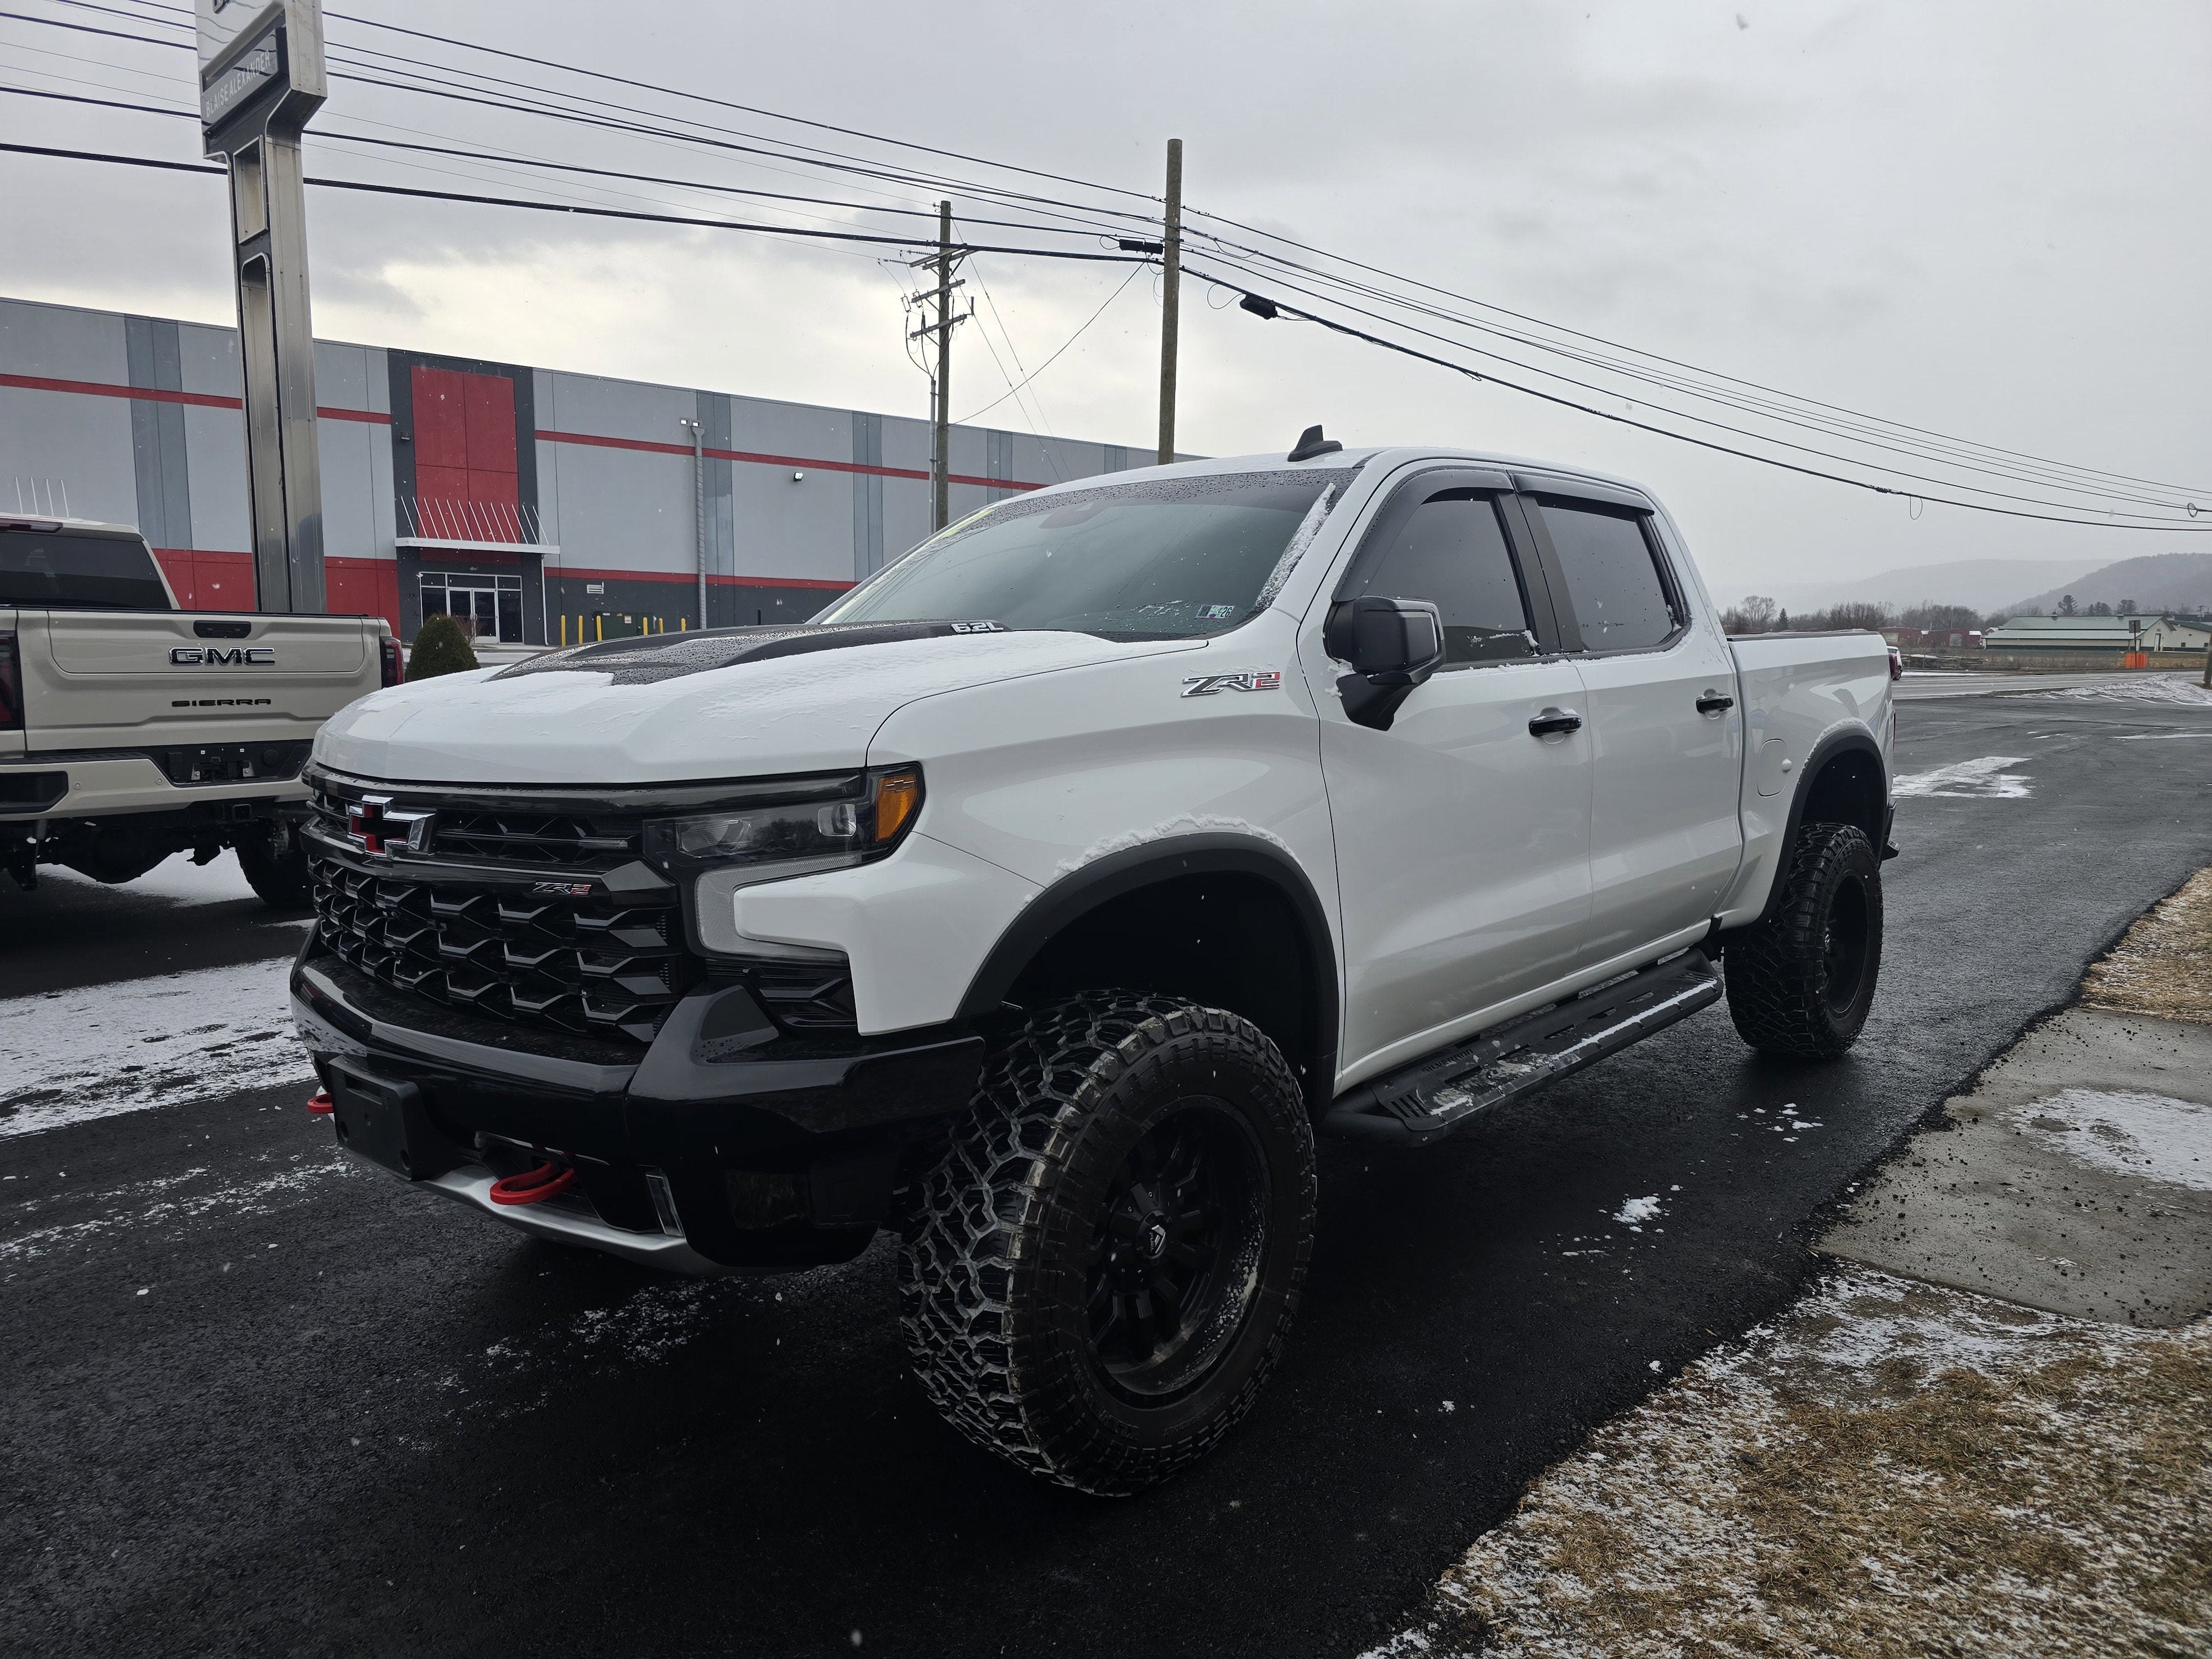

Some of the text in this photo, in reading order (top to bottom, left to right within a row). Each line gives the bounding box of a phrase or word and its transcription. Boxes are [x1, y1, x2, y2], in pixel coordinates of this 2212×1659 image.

[206, 49, 270, 118] BLAISE ALEXANDER
[1220, 607, 1233, 618] 26
[169, 647, 275, 666] GMC
[1180, 671, 1280, 698] ZR2
[171, 698, 272, 707] SIERRA
[532, 881, 592, 896] ZR2
[1421, 1048, 1474, 1072] SILVERADO
